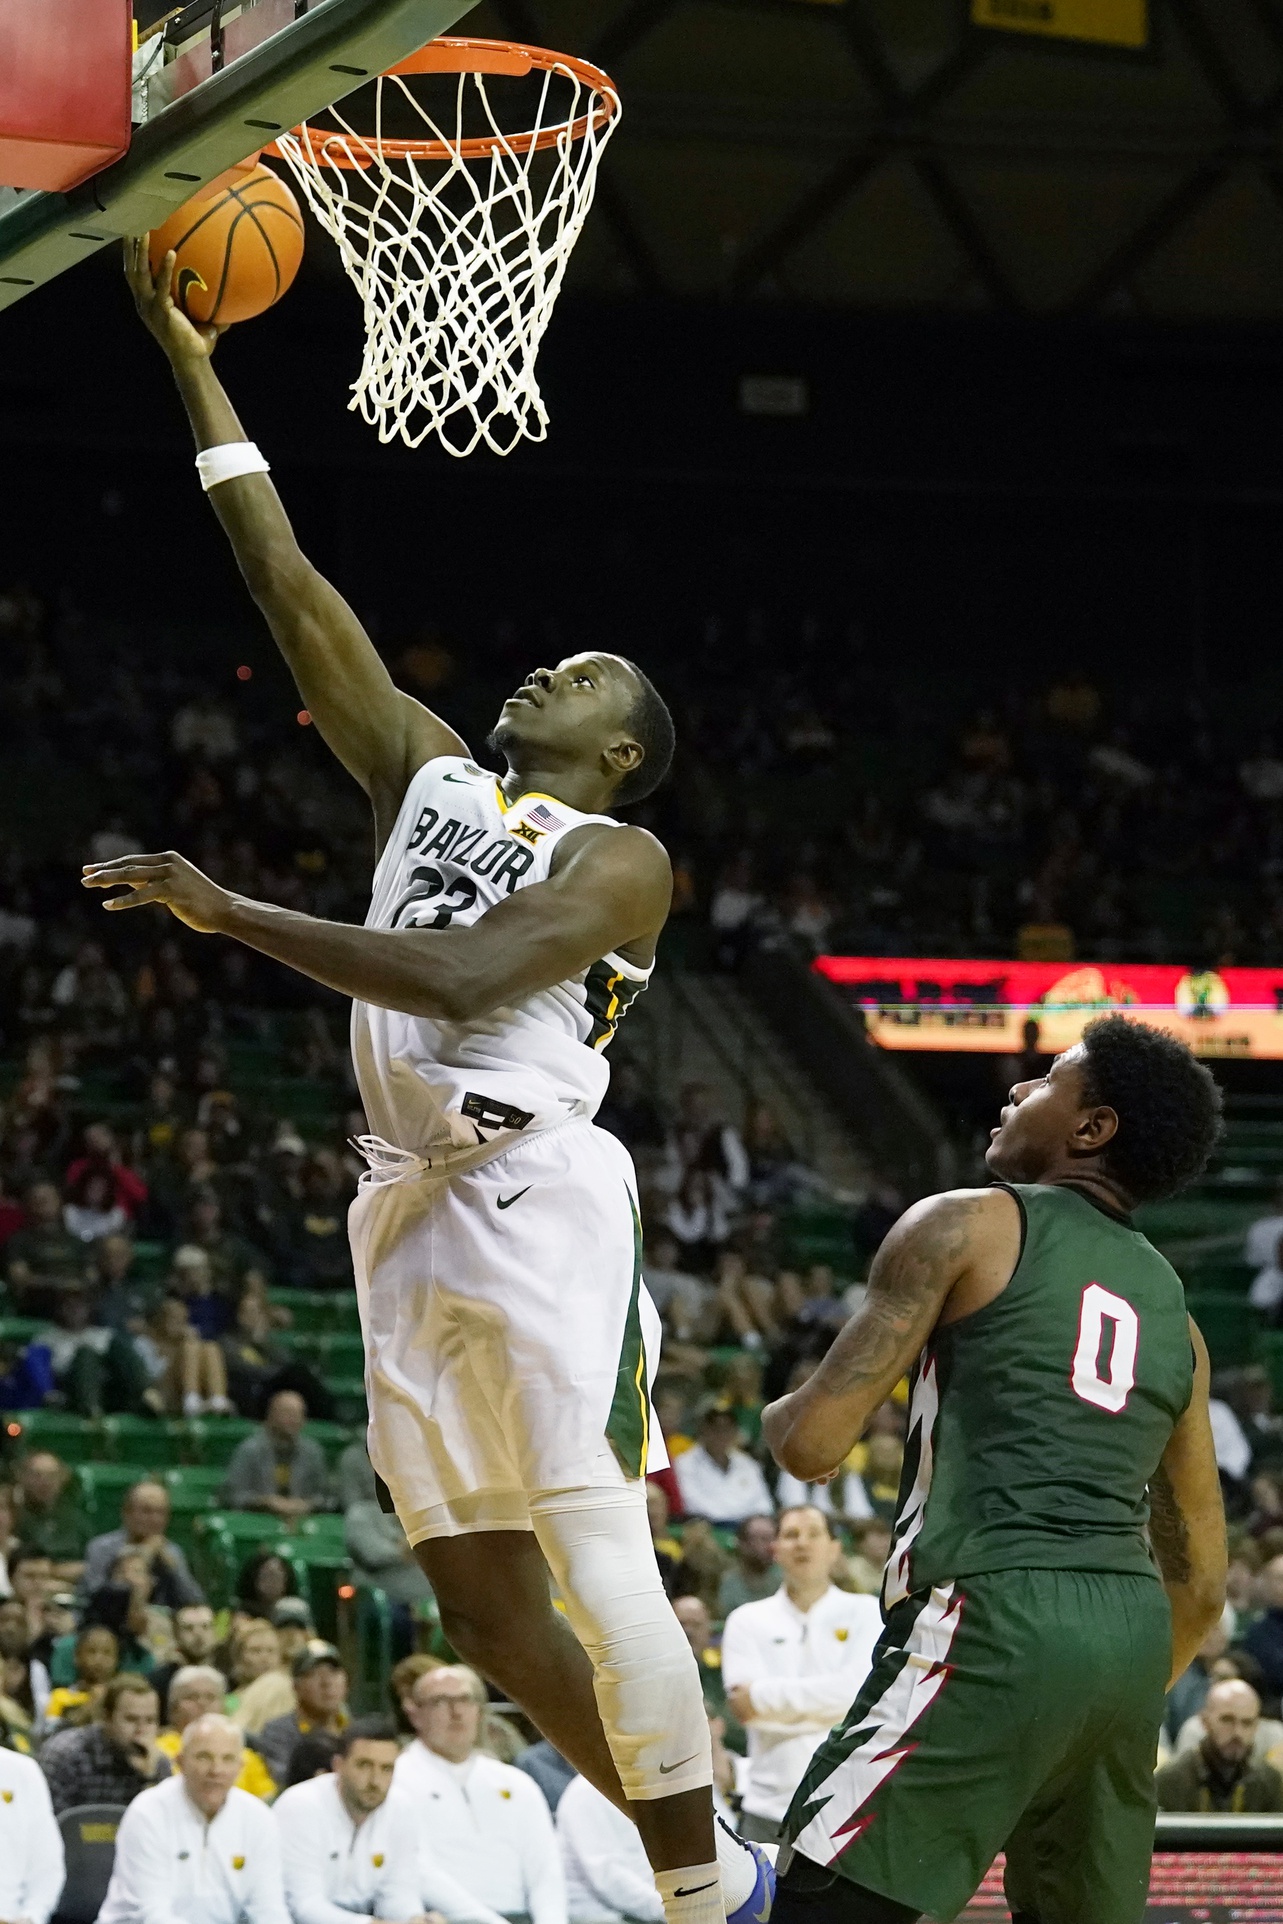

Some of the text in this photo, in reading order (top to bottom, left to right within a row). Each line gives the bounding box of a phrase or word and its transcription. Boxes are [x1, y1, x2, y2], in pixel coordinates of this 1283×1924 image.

[407, 807, 535, 894] BAYLOR
[390, 866, 477, 930] 23
[509, 1113, 522, 1125] 50
[1069, 1281, 1140, 1414] 0
